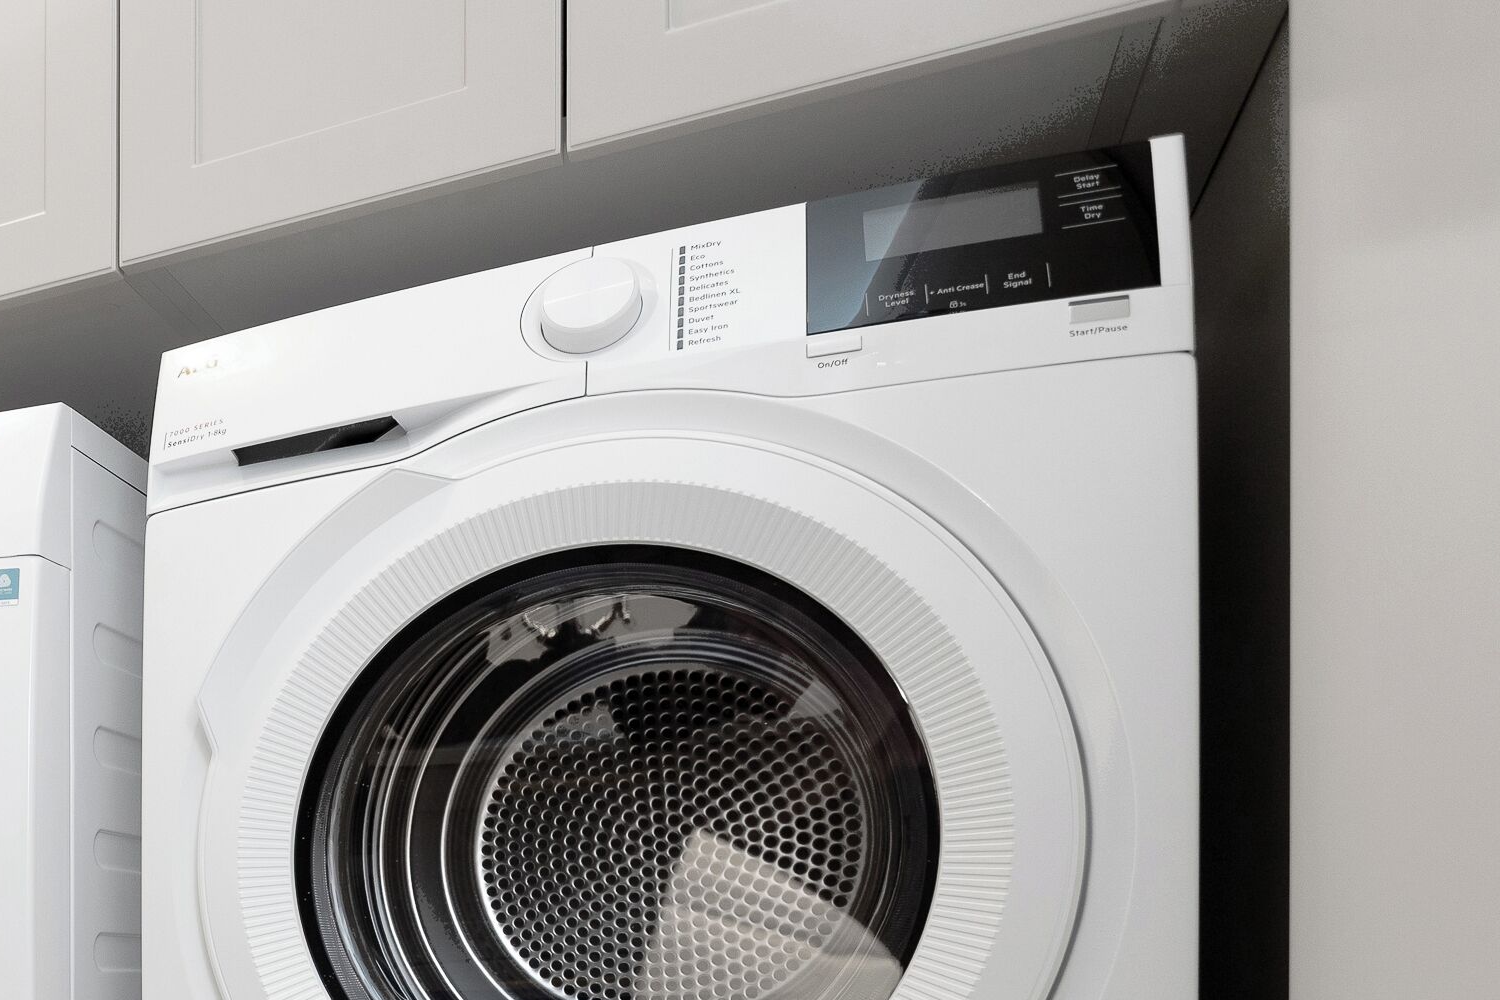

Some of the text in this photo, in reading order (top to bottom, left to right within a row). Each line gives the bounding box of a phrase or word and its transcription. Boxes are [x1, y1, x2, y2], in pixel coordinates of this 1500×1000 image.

[1073, 174, 1100, 183] Delay
[1076, 181, 1100, 190] Start
[1080, 204, 1104, 212] Time
[690, 241, 722, 251] MixDry
[690, 260, 724, 271] Cottons
[689, 268, 735, 281] Synthetics
[1007, 271, 1027, 280] End
[689, 280, 729, 292] Delicates
[937, 283, 985, 295] Anti Crease
[1003, 278, 1032, 289] Signal
[689, 291, 727, 302] Bedlinen
[878, 291, 915, 302] Dryness
[688, 300, 739, 313] Sportswear
[885, 297, 909, 308] Level
[688, 315, 714, 324] Duvet
[688, 327, 709, 335] Easy
[1069, 325, 1128, 338] Start/Pause
[688, 336, 722, 346] Refresh
[817, 358, 848, 369] On/Off
[169, 419, 224, 437] 7000 SERIES
[167, 434, 205, 448] SensiDry
